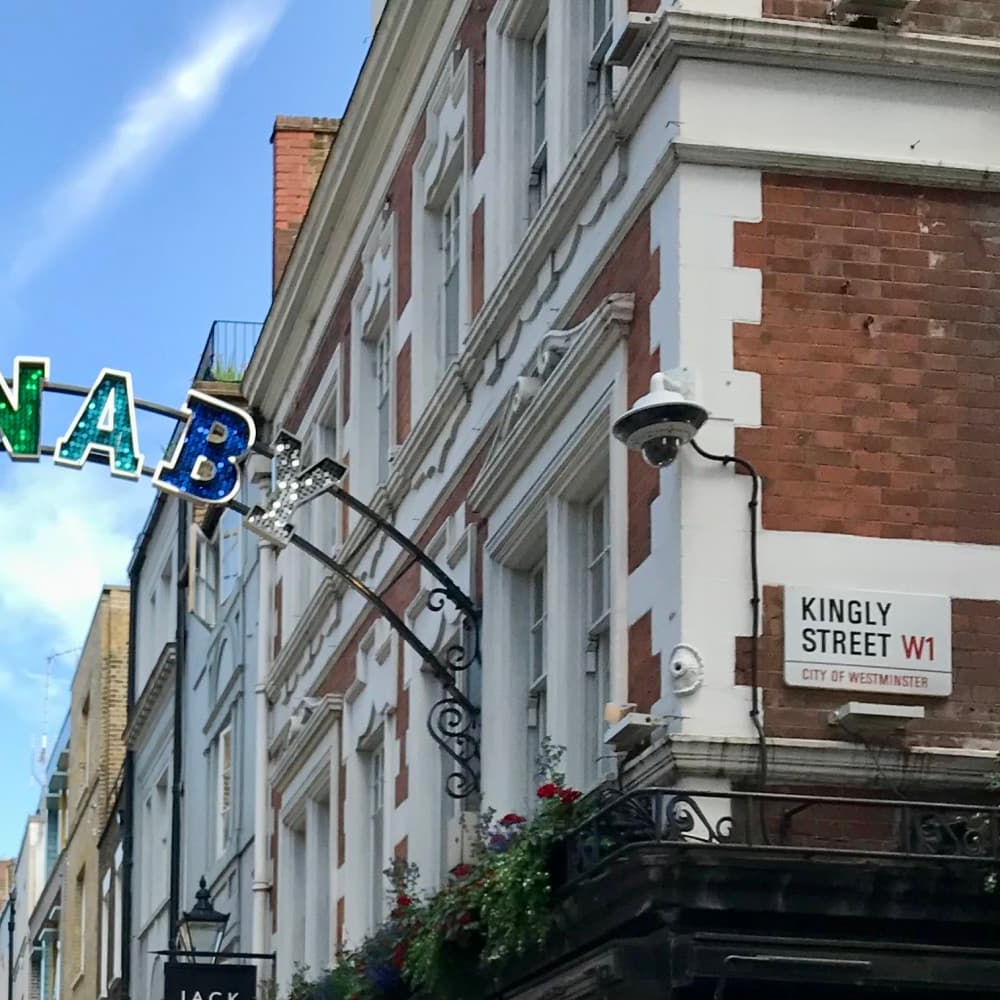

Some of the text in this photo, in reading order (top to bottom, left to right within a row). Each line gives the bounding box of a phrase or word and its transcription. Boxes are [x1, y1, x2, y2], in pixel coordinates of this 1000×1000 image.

[801, 596, 892, 627] KINGLY
[801, 628, 935, 661] STREET W1
[802, 667, 928, 689] CITY OF WESTMINSTER
